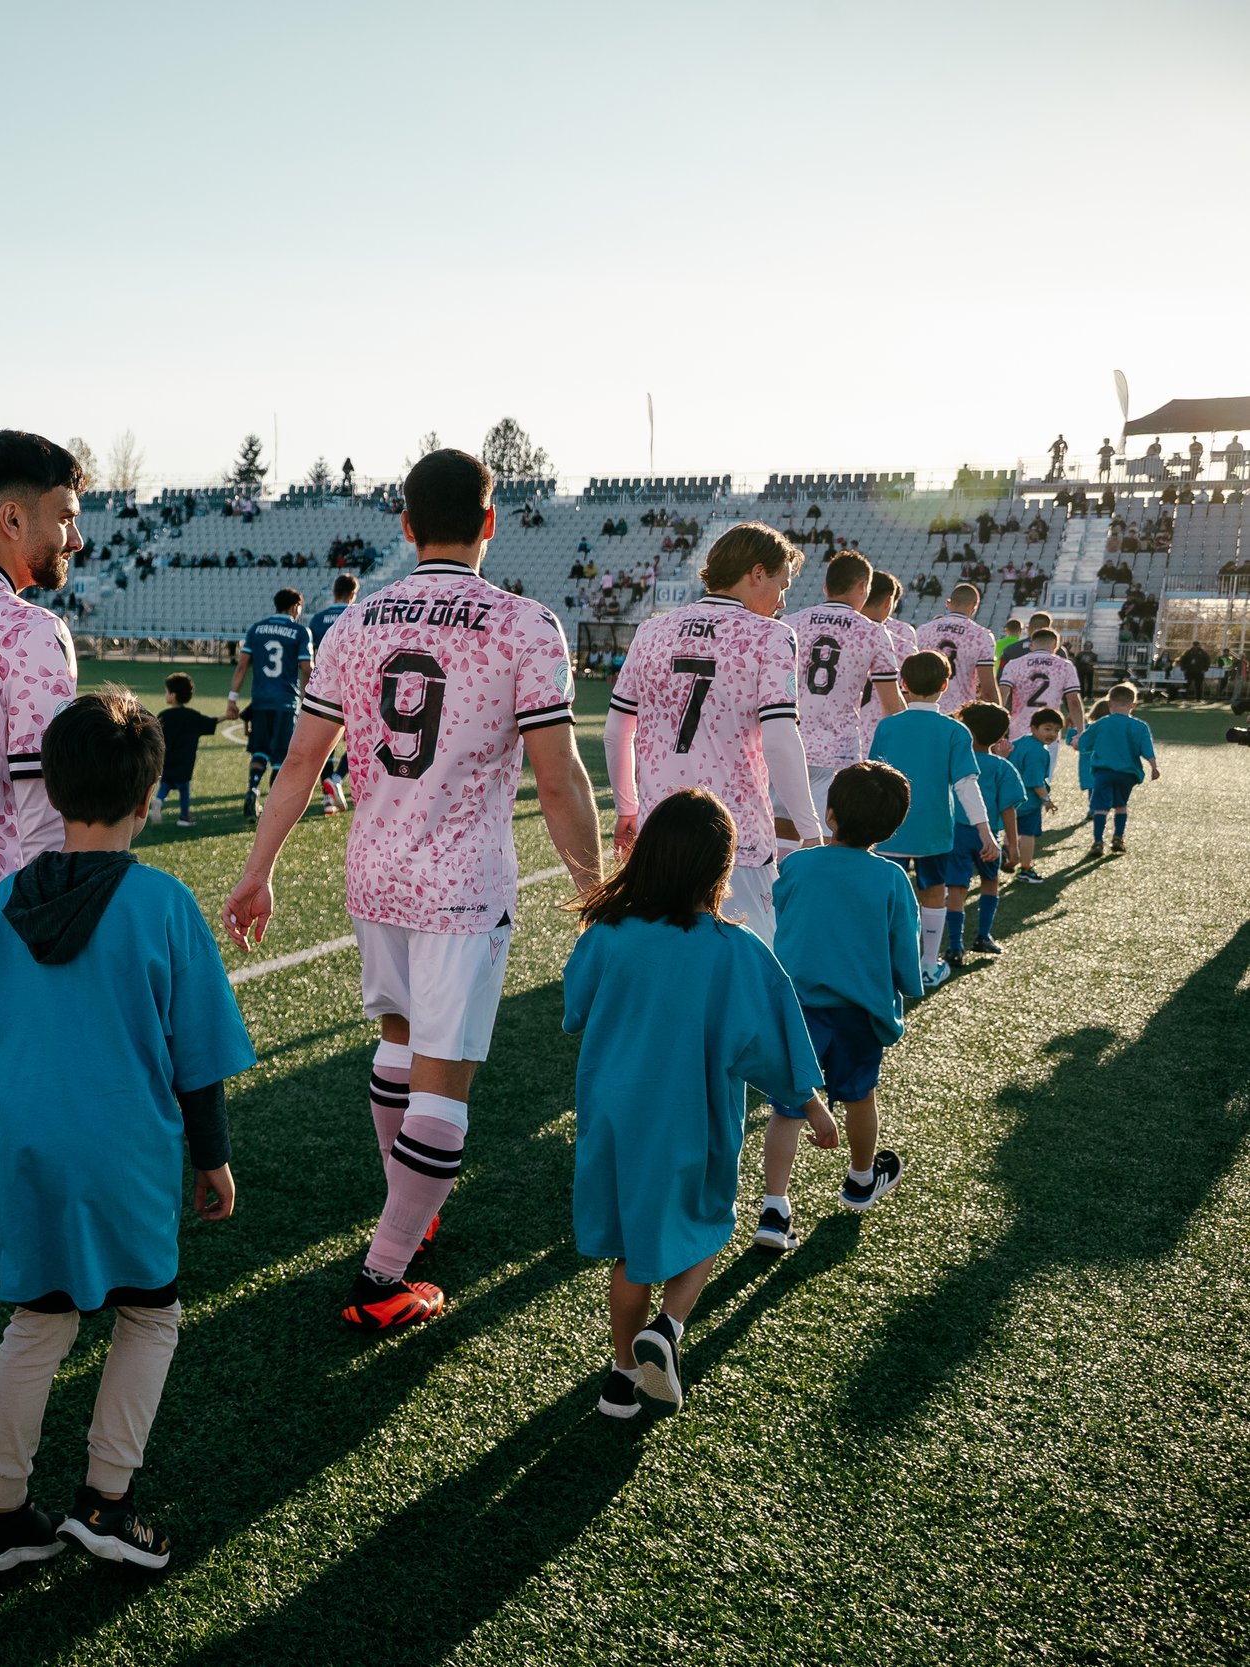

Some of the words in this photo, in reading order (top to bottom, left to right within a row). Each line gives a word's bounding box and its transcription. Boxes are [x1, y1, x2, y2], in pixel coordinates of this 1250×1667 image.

[362, 599, 424, 626] WERO
[427, 595, 492, 631] DÍAZ
[678, 619, 721, 639] FISK
[810, 613, 852, 628] RENAN
[255, 624, 298, 639] FERNANDEZ
[262, 640, 284, 678] 3
[805, 634, 841, 695] 8
[670, 655, 717, 754] 7
[1026, 672, 1050, 707] 2
[373, 648, 447, 779] 9
